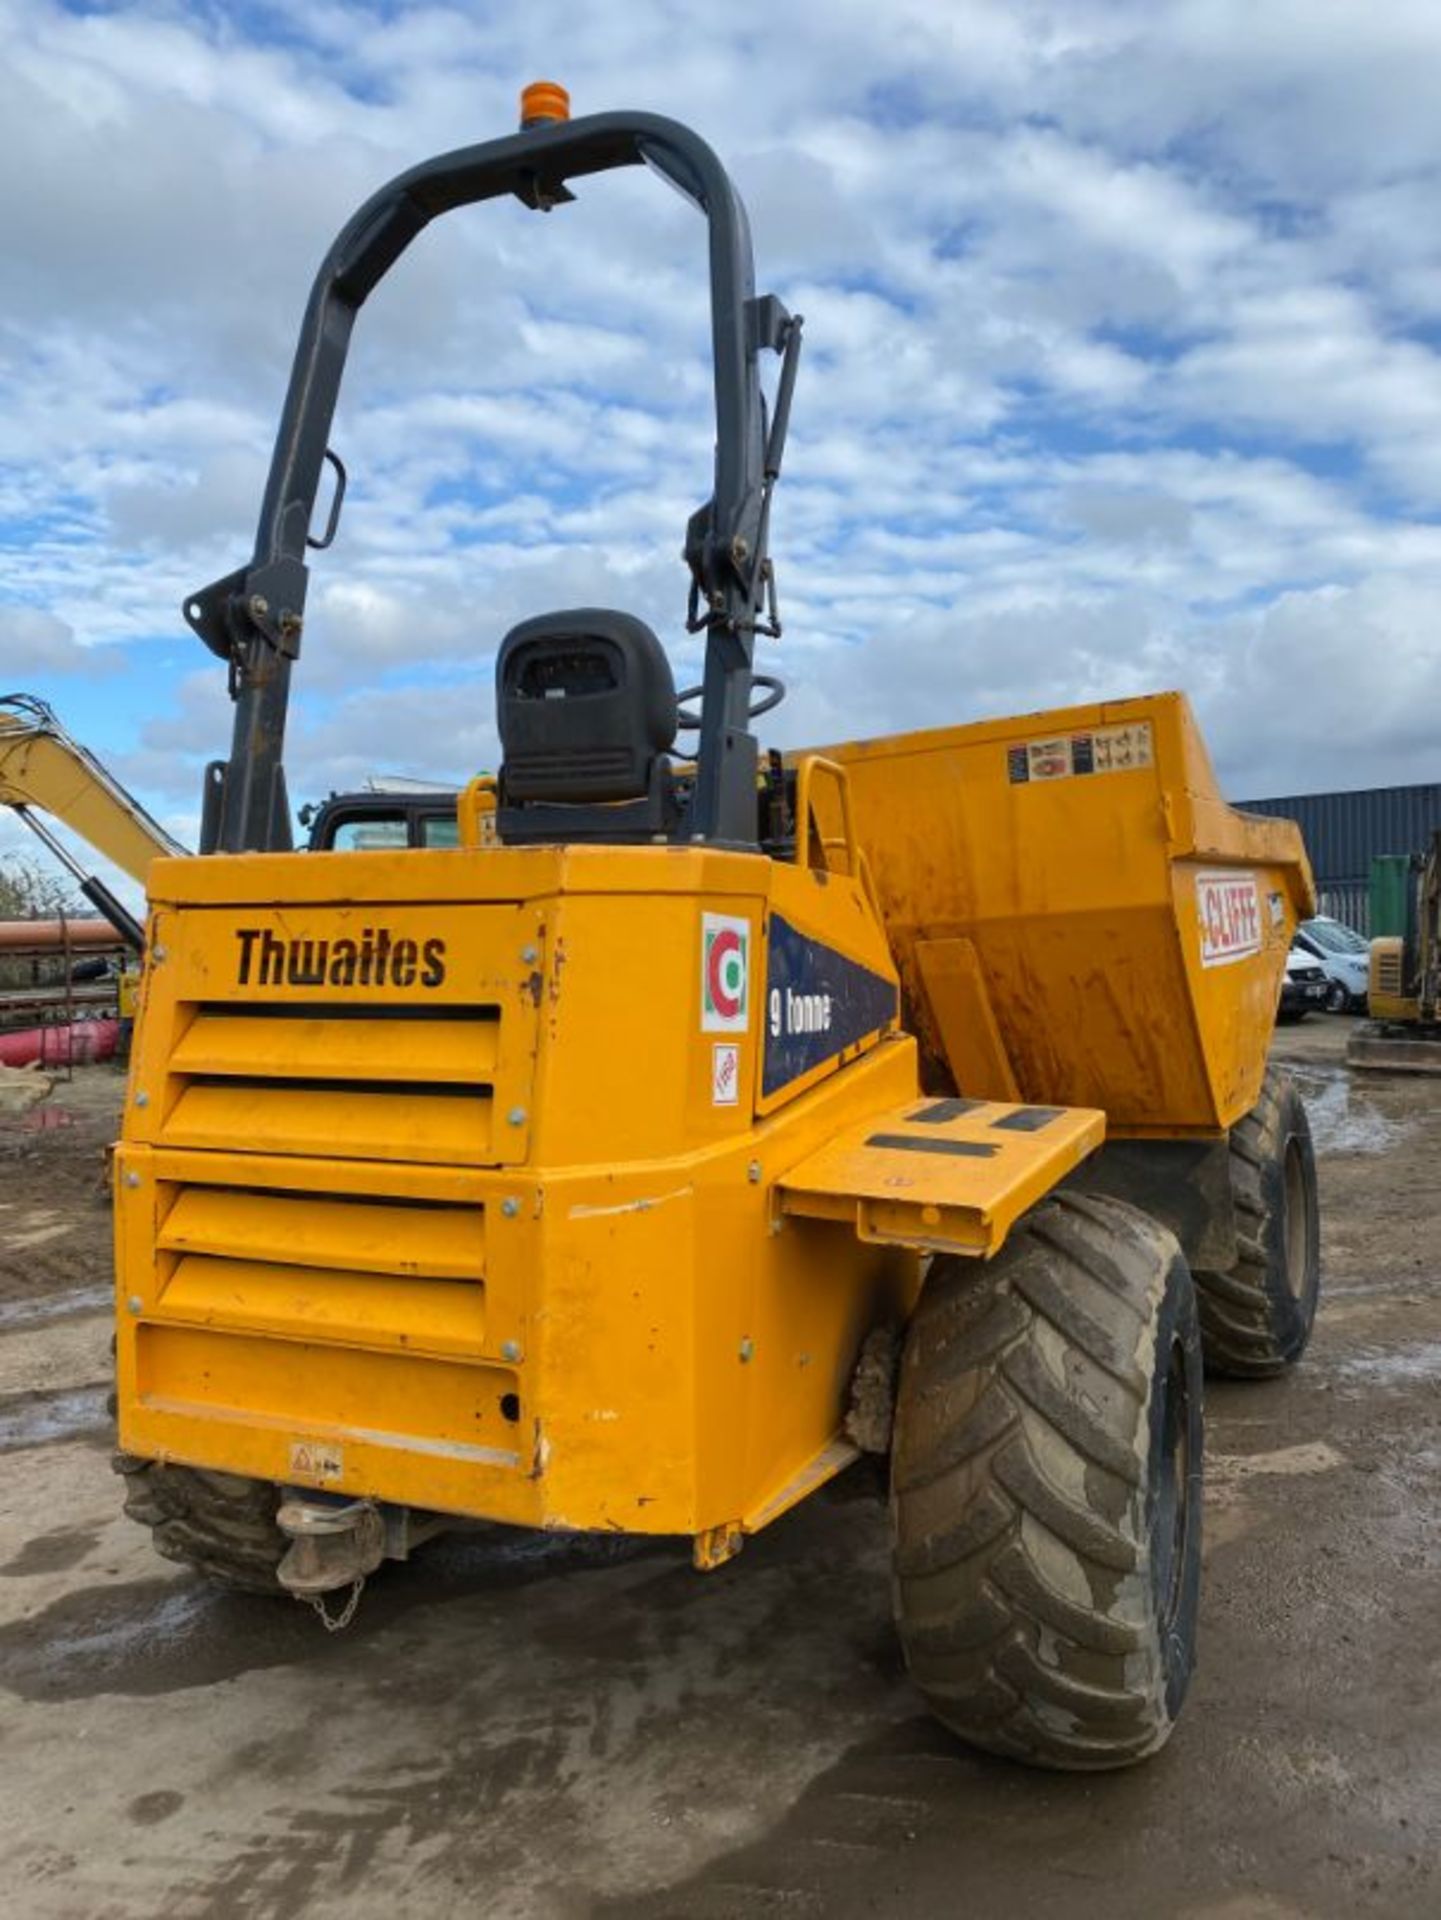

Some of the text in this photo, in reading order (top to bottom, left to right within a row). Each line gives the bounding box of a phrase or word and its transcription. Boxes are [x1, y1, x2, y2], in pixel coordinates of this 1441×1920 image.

[236, 928, 446, 987] Thwaites
[769, 987, 831, 1037] 9 tonne
